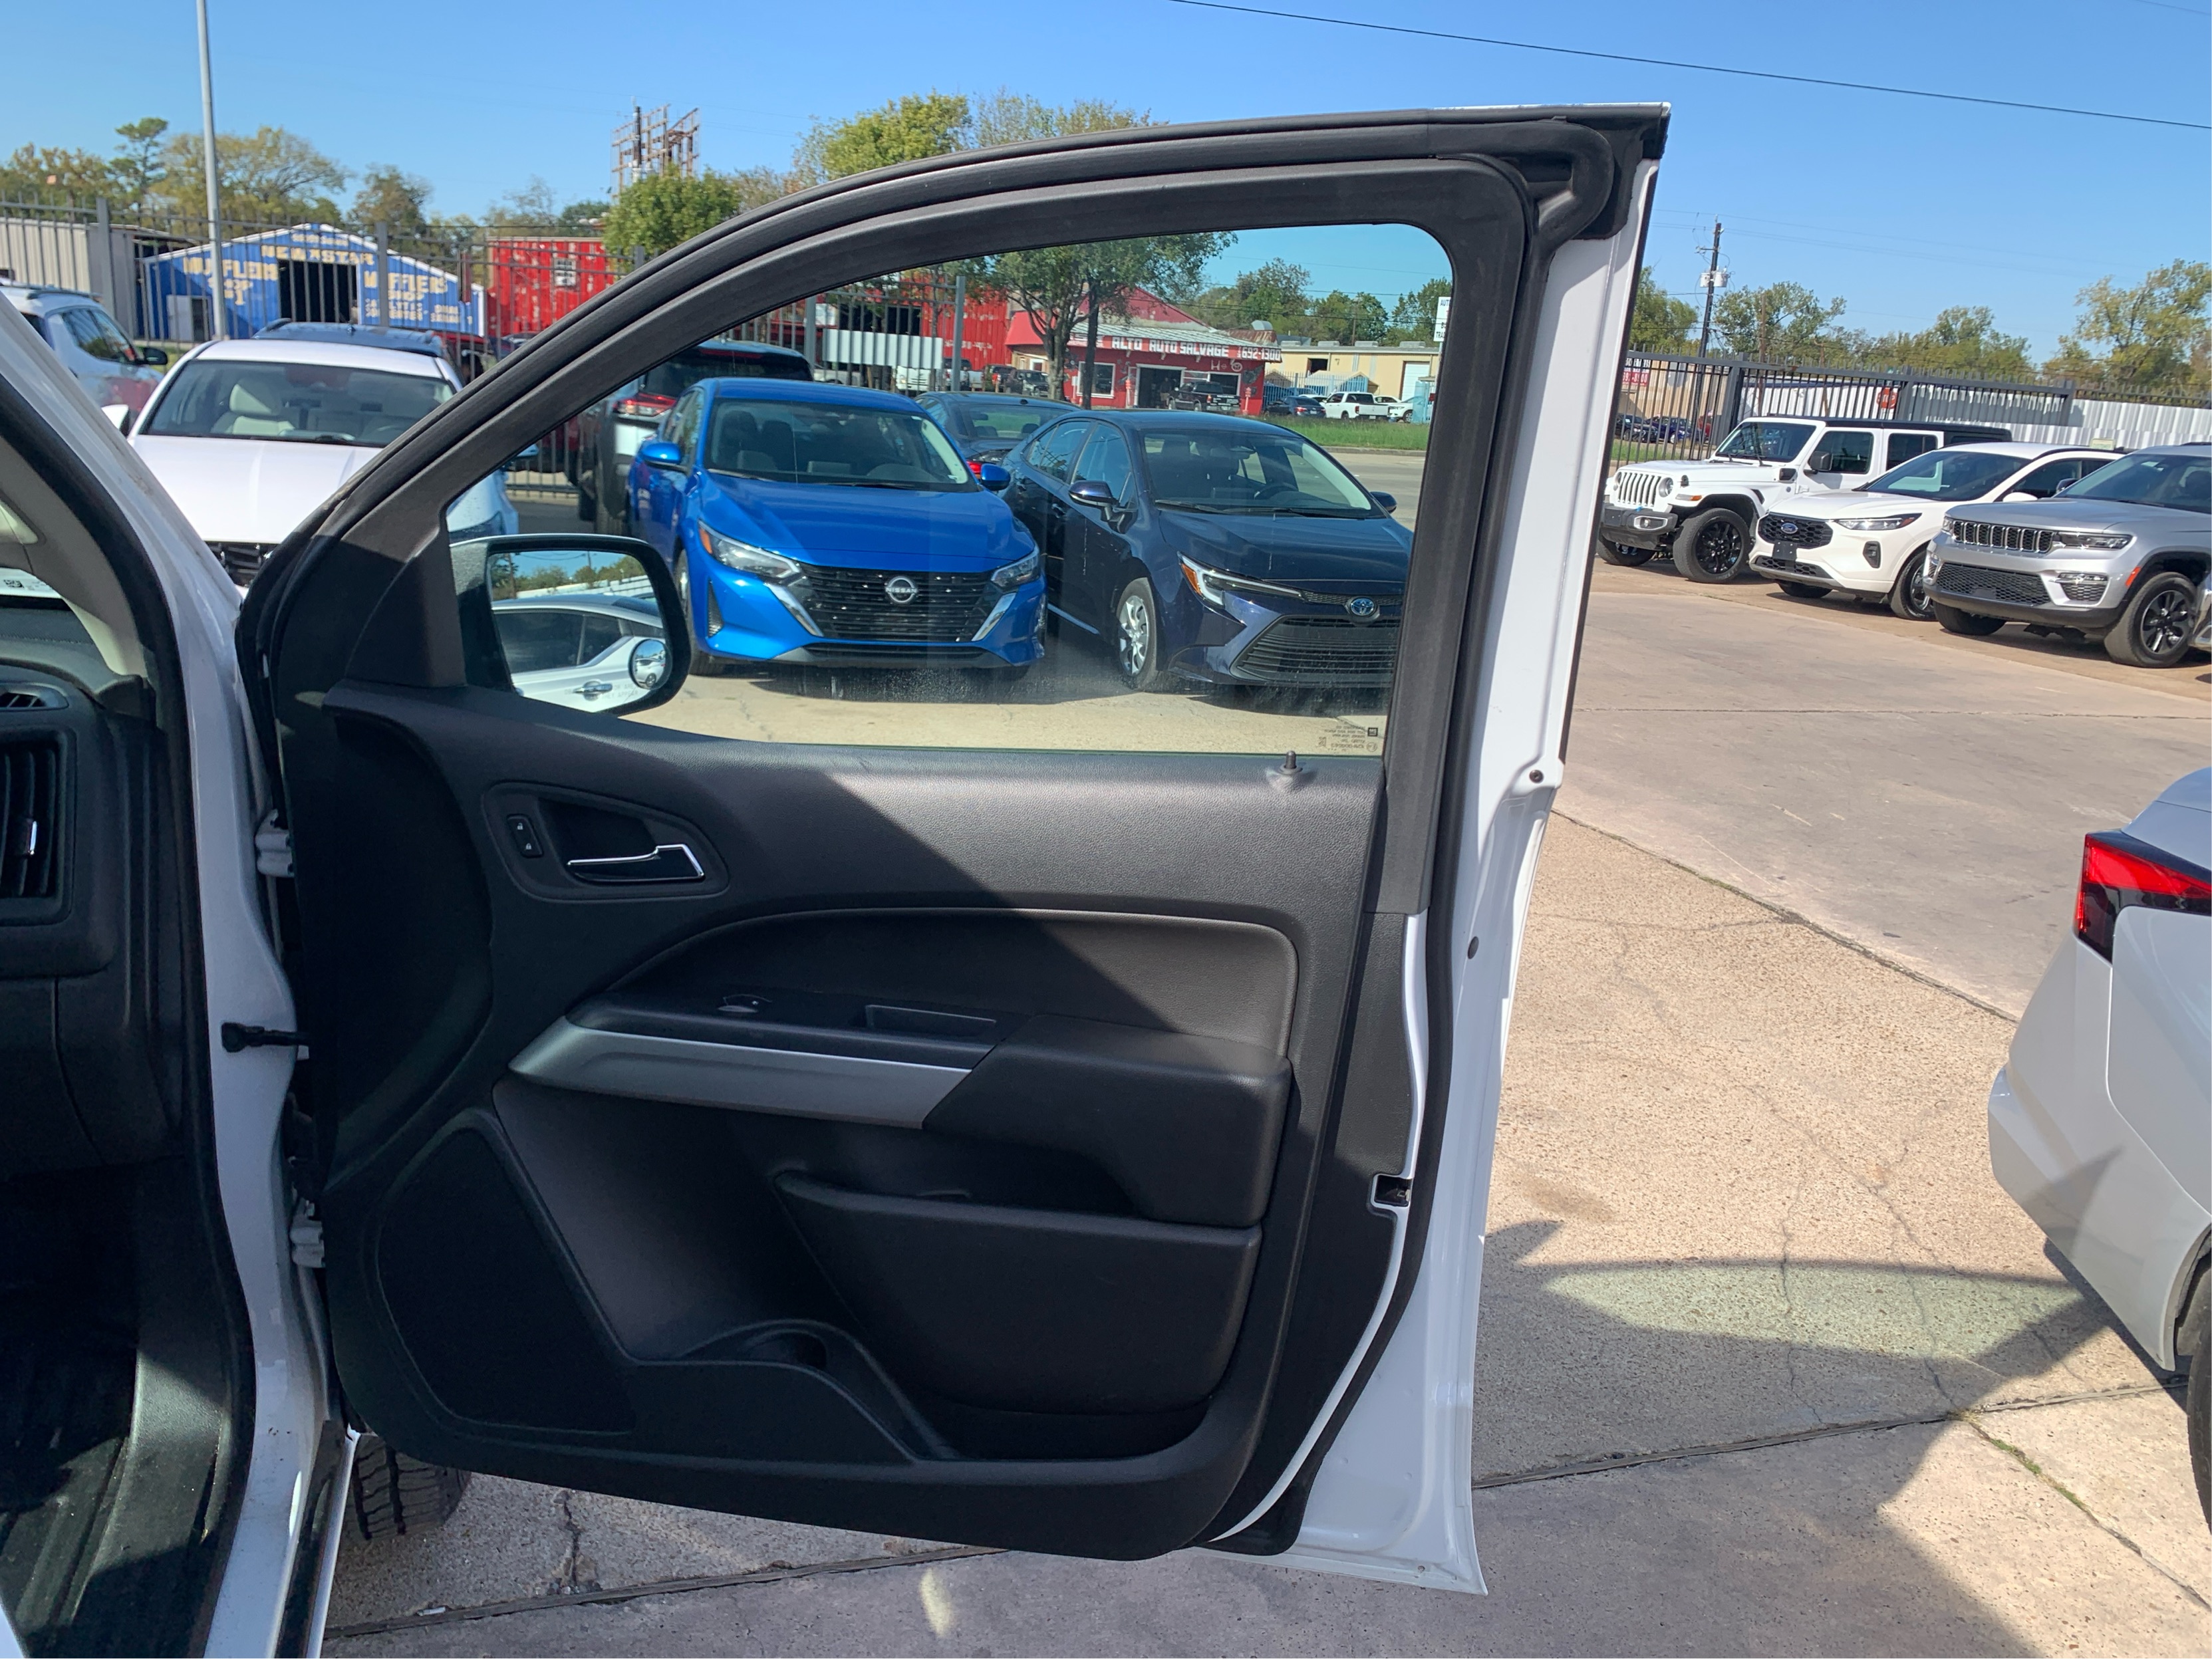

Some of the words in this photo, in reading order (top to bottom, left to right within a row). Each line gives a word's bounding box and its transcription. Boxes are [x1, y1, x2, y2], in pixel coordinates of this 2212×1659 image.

[364, 271, 448, 294] MFFLERS
[1112, 336, 1142, 351] ALTO
[1149, 339, 1177, 354] AUTO
[1180, 341, 1229, 358] SALVAGE
[1242, 346, 1282, 362] 692-1300
